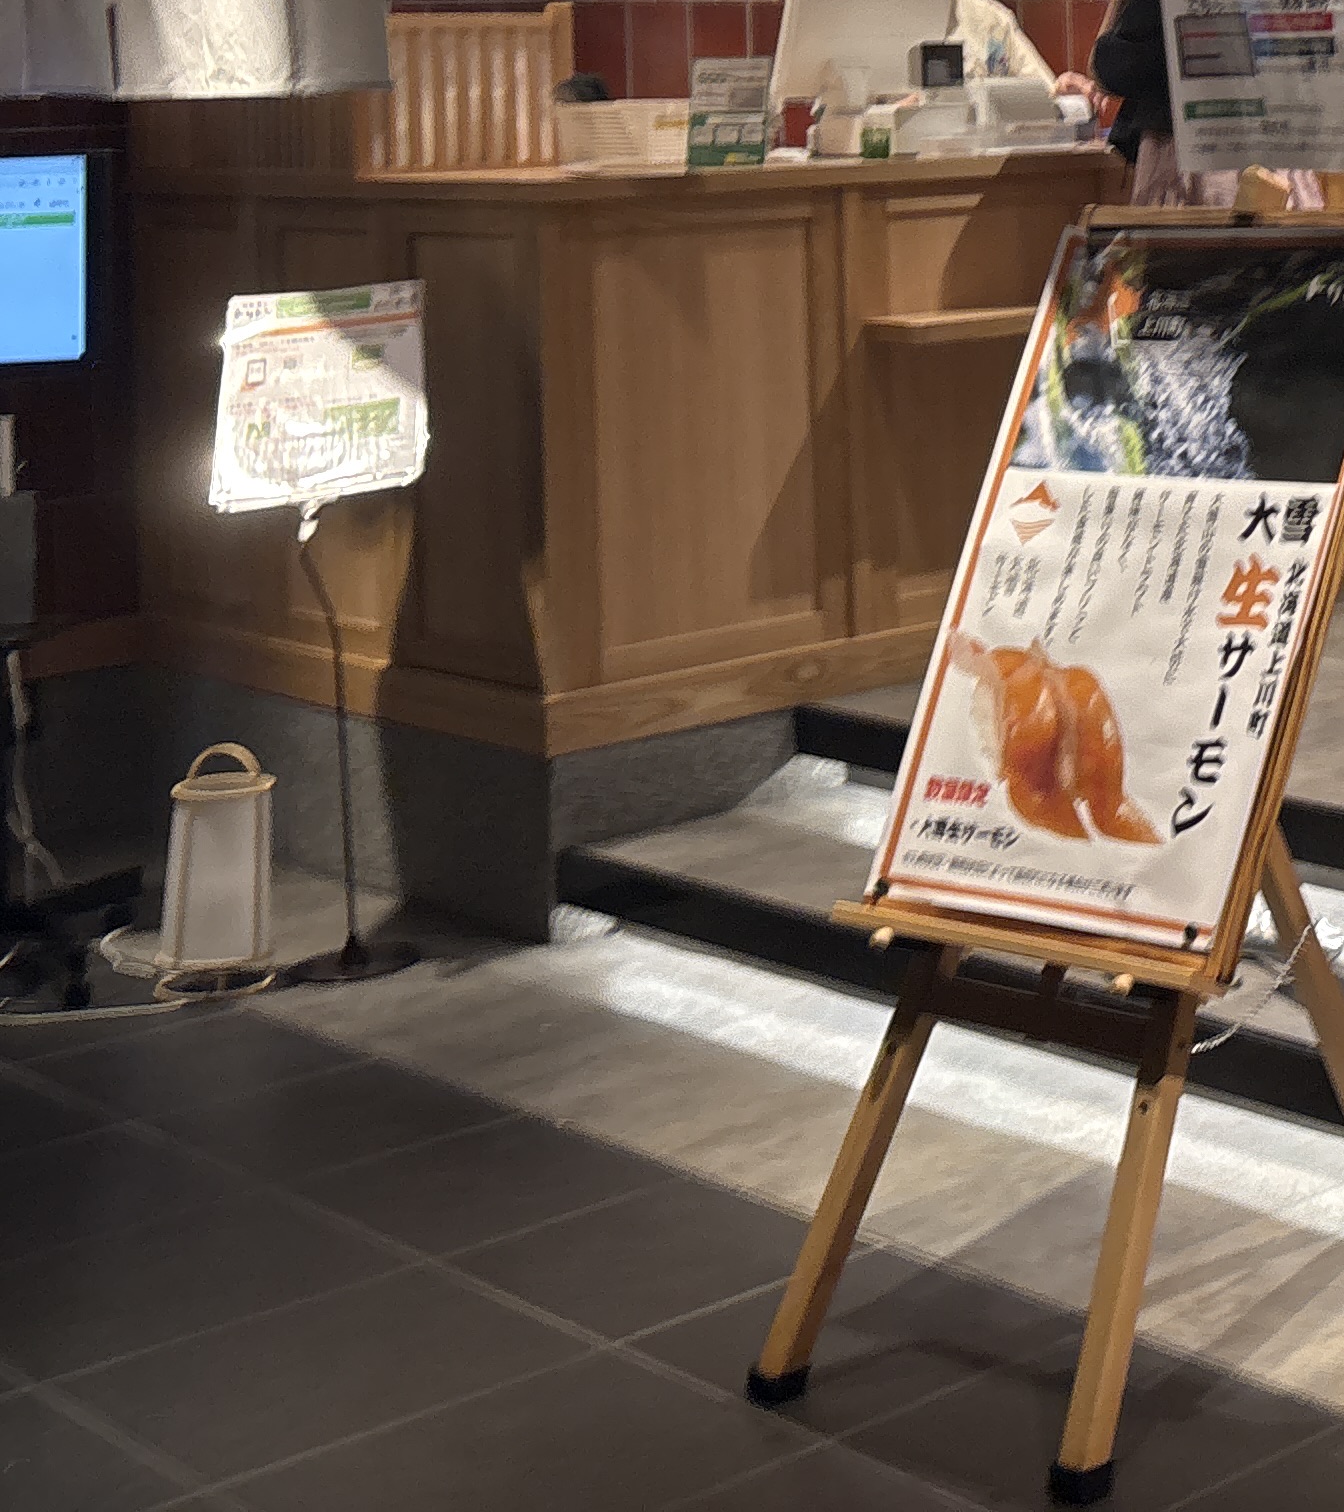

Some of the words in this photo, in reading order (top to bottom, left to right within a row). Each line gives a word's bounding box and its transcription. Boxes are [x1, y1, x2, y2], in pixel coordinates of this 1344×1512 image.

[1238, 491, 1321, 546] 大雪
[1170, 552, 1282, 838] 生サーモン
